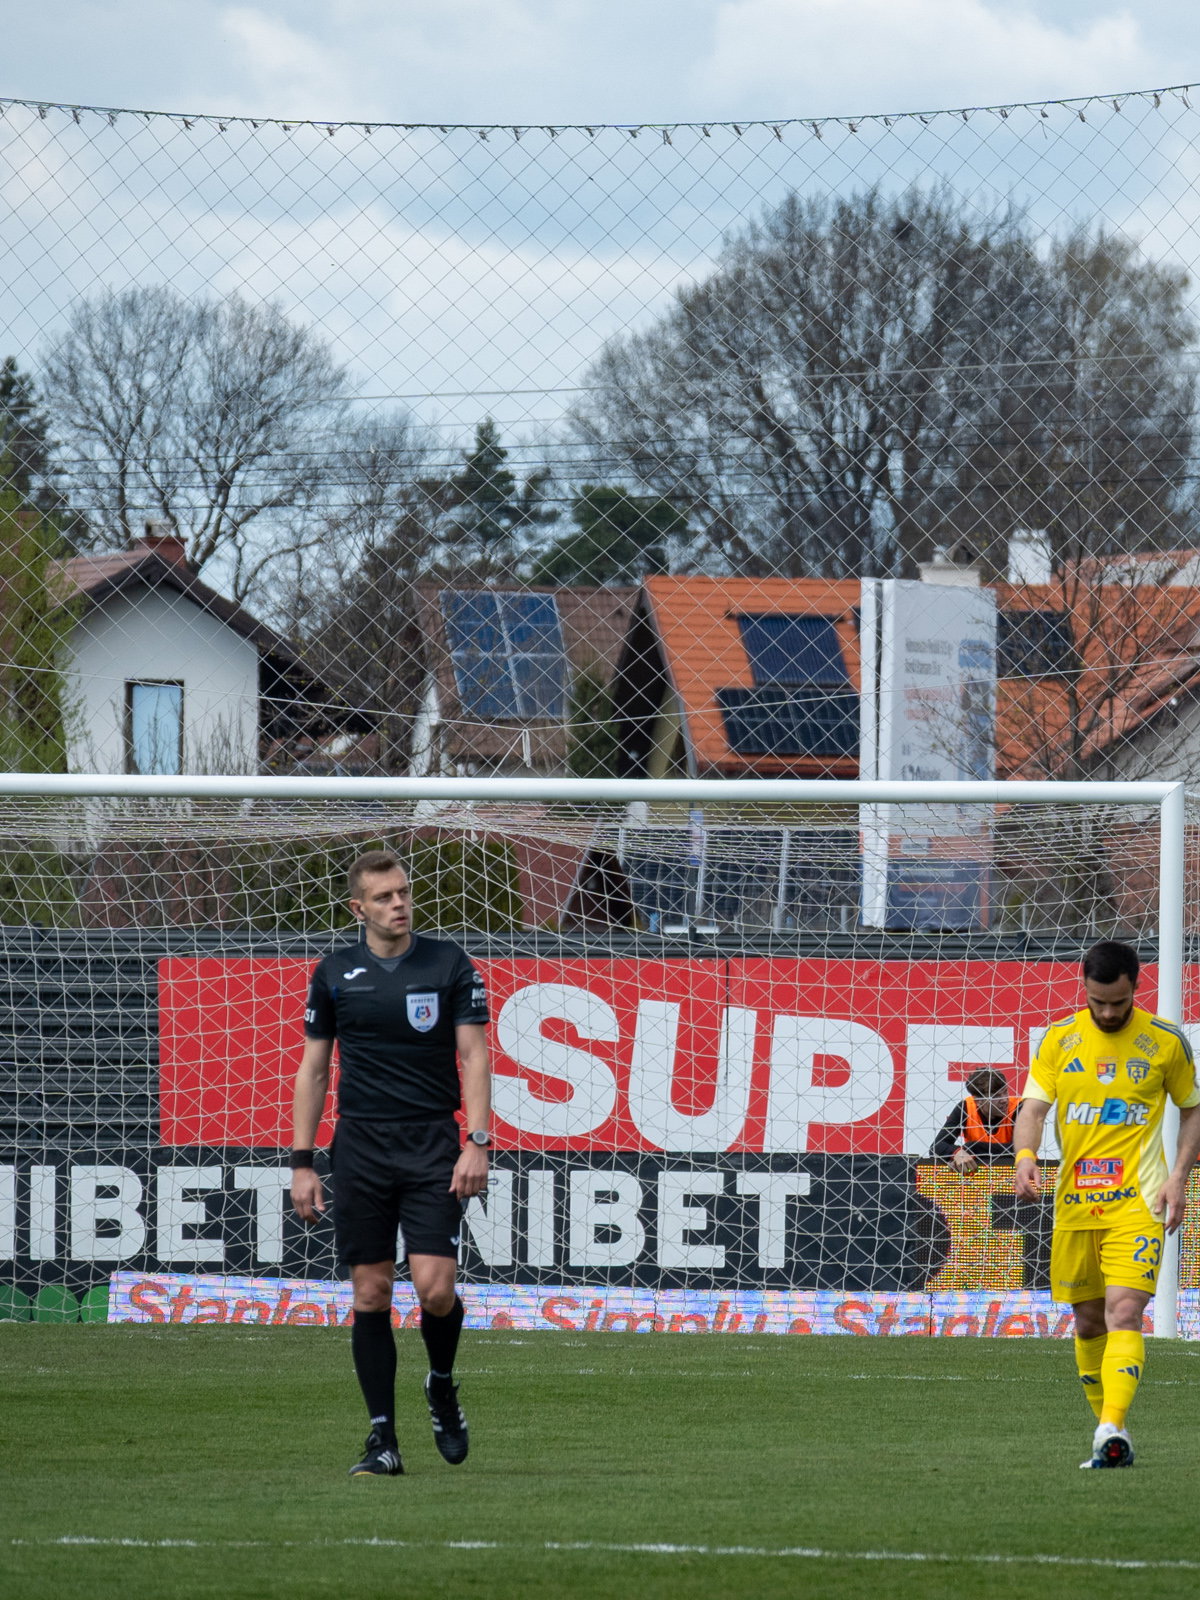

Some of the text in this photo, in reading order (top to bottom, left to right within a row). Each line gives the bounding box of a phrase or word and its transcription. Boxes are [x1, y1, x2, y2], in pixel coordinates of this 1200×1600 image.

[1065, 1098, 1149, 1126] MrBit
[1075, 1160, 1121, 1175] T&T
[1076, 1179, 1113, 1187] DEPO
[1085, 1186, 1138, 1203] HOLDING
[1133, 1235, 1162, 1267] 23
